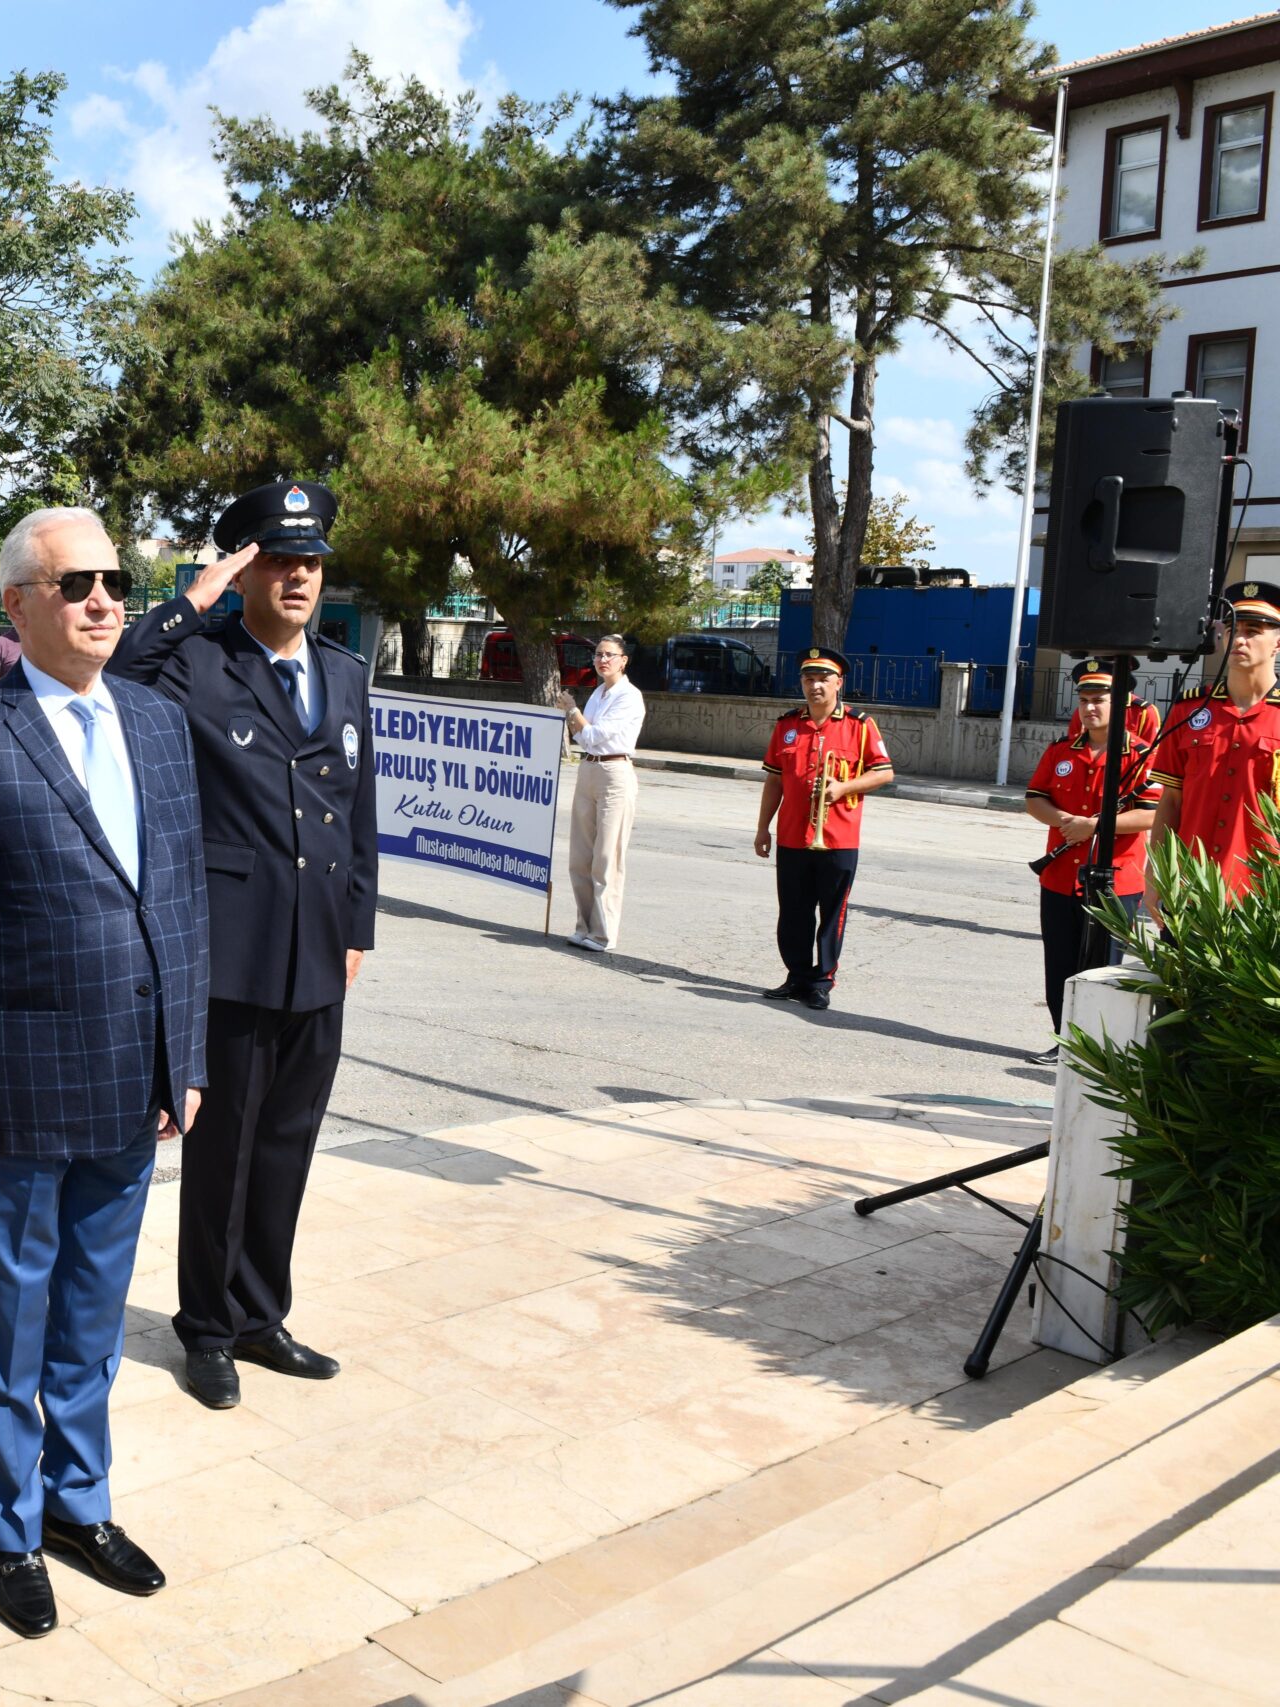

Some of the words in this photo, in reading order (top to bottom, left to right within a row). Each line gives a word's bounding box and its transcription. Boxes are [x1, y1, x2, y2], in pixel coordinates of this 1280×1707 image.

[442, 761, 469, 790] YIL
[474, 761, 554, 806] DÖNÜMÜ
[394, 794, 453, 821] Kutlu
[458, 804, 515, 834] Olsun
[415, 834, 502, 872] Mustafakemalpaşa
[503, 854, 548, 884] Belediyesi
